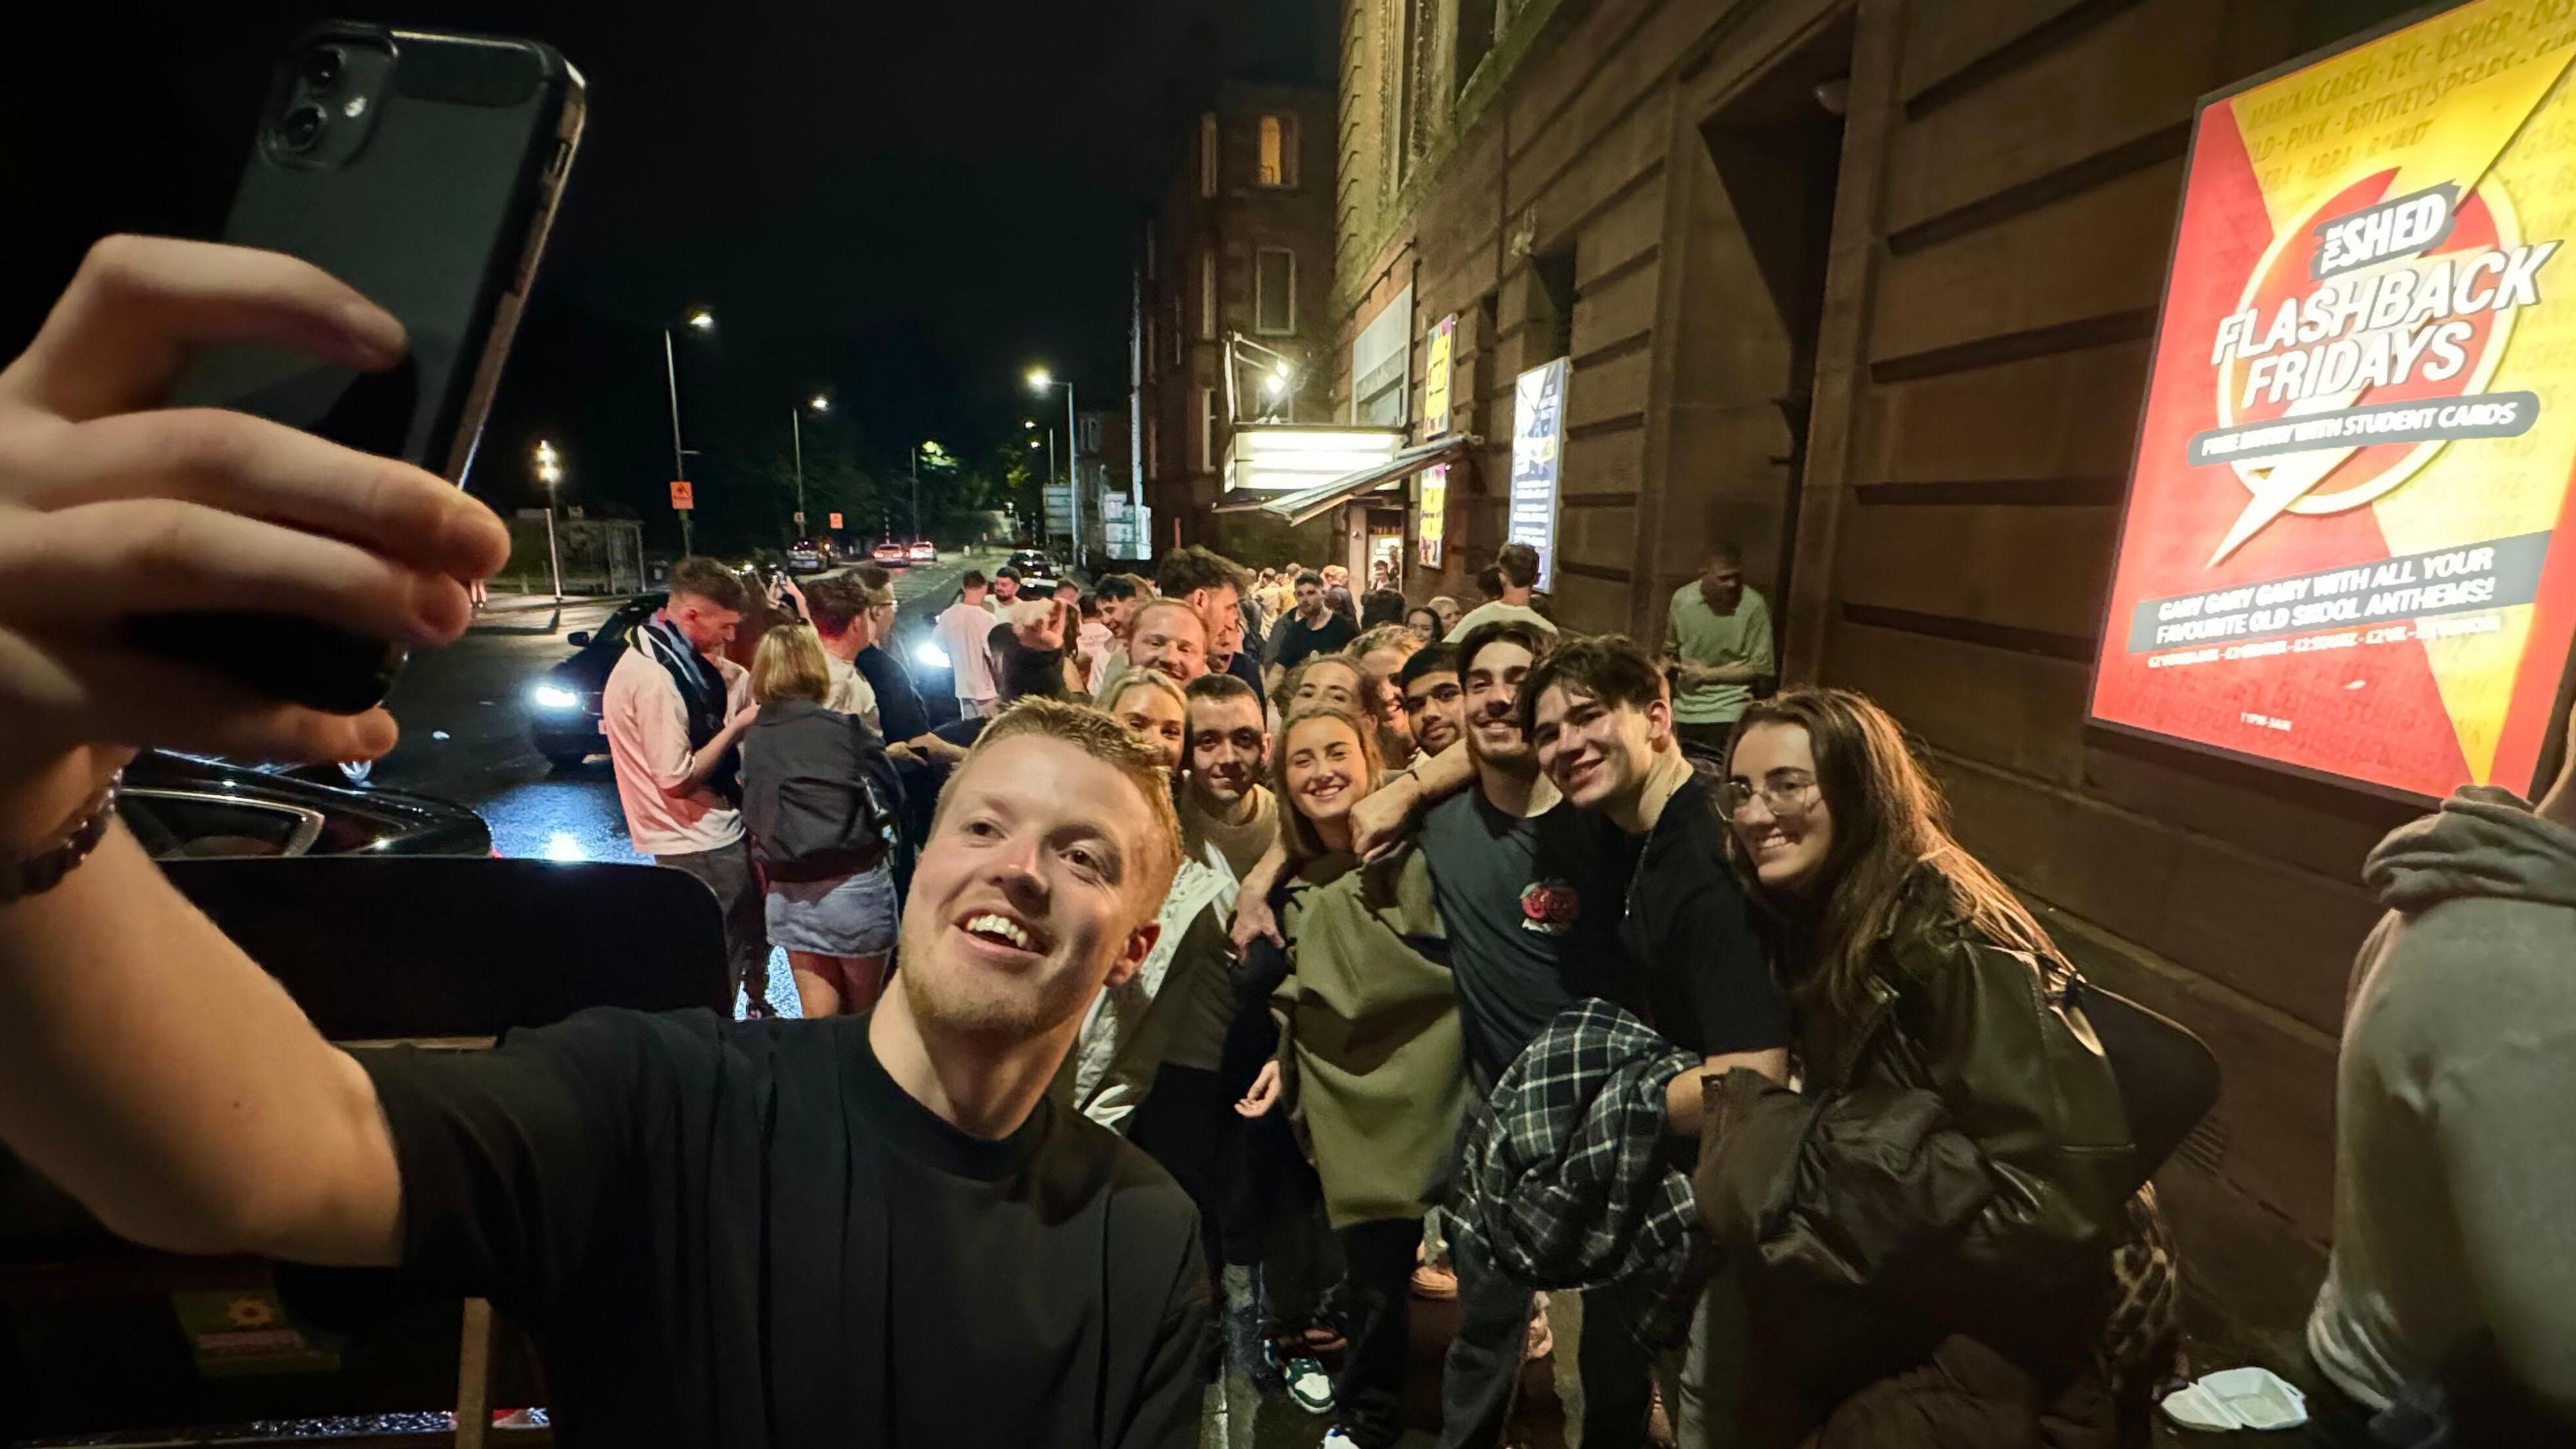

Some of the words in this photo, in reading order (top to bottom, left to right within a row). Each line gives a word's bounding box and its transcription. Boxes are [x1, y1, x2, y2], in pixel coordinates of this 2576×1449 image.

[2340, 194, 2447, 266] SHED
[2210, 239, 2564, 366] FLASHBACK
[2241, 321, 2472, 409] FRIDAYS
[2295, 418, 2344, 441] WITH
[2343, 408, 2438, 435] STUDENT
[2438, 402, 2517, 427] CARDS
[2313, 568, 2371, 597] WITH
[2370, 561, 2416, 588] ALL
[2423, 547, 2495, 580] YOUR
[2156, 613, 2249, 644] FAVOURITE
[2249, 608, 2292, 633] OLD
[2363, 577, 2495, 616] ANTHEMS!
